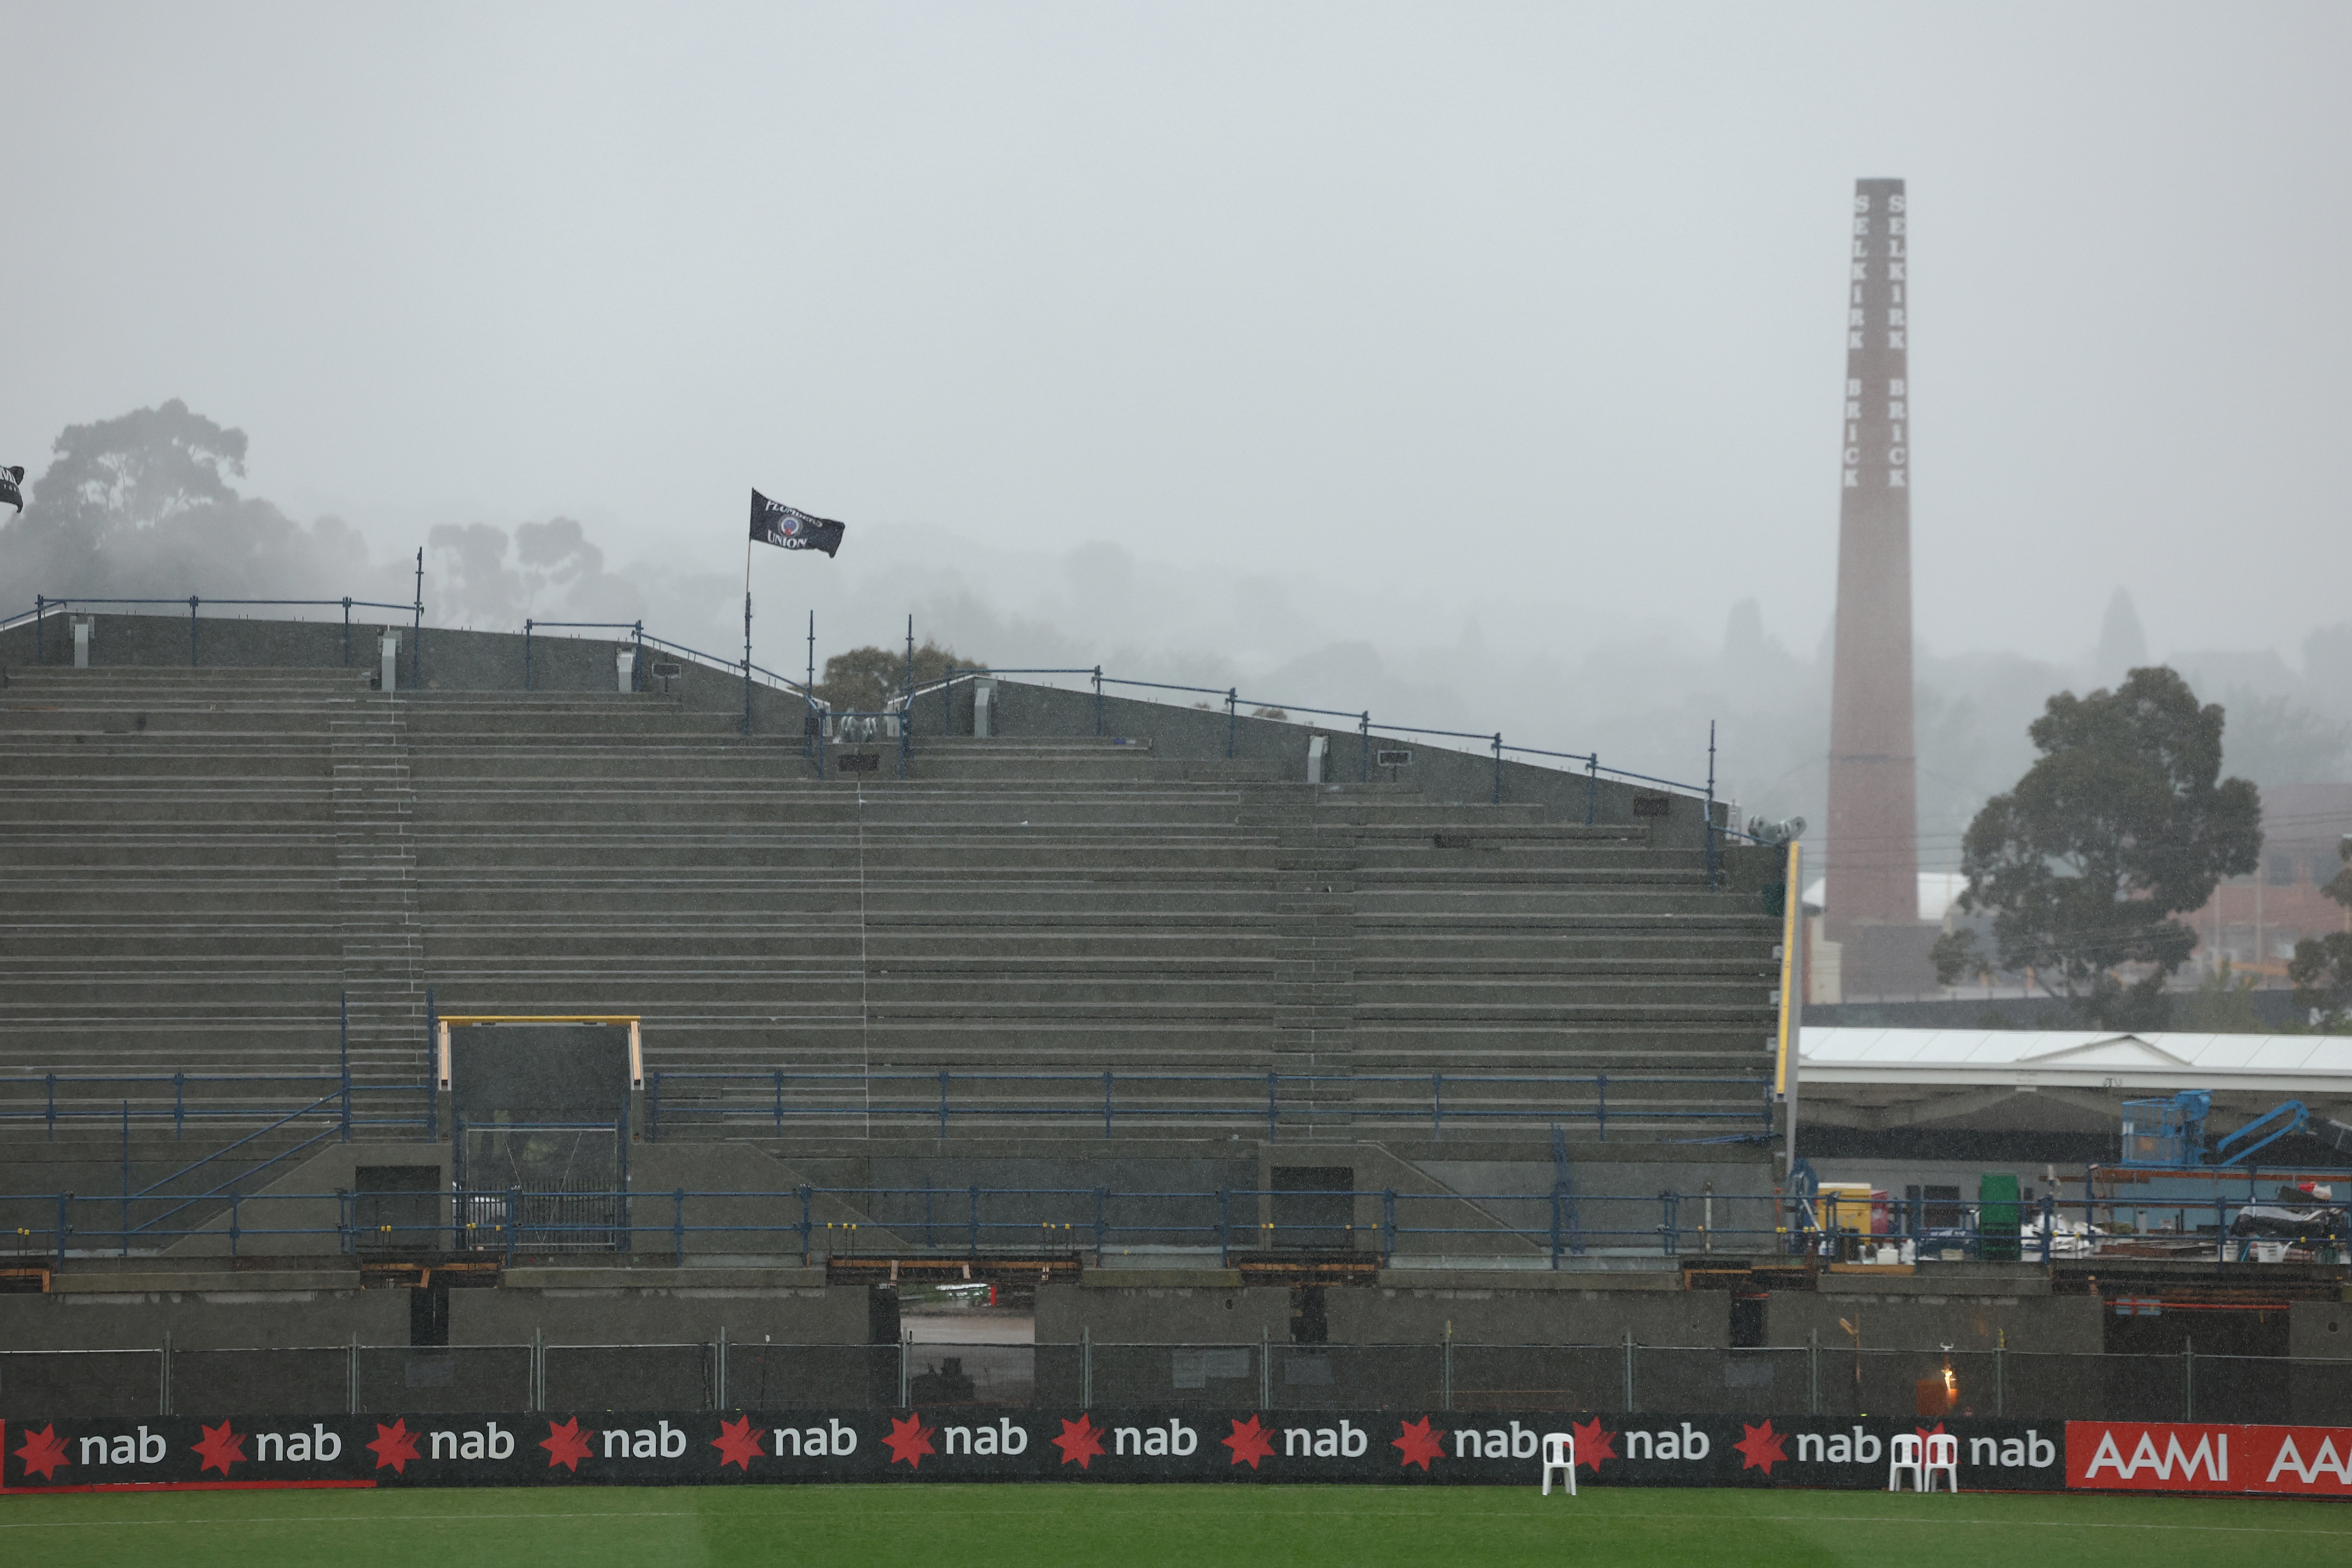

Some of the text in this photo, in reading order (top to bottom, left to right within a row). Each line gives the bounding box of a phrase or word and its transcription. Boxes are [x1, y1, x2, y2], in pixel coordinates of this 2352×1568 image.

[1844, 194, 1870, 487] SELKIRK BRICK
[1888, 194, 1906, 487] SELKIRK BRICK
[767, 529, 808, 549] UNION
[80, 1425, 166, 1465] nab
[256, 1423, 341, 1461] nab
[430, 1422, 515, 1460] nab
[603, 1420, 686, 1458] nab
[773, 1418, 857, 1456] nab
[944, 1417, 1028, 1455] nab
[1114, 1418, 1198, 1456] nab
[1284, 1420, 1368, 1457] nab
[1454, 1421, 1538, 1458] nab
[1625, 1422, 1709, 1460] nab
[1797, 1426, 1881, 1463] nab
[1969, 1430, 2055, 1468] nab
[2085, 1430, 2228, 1482] AAMI
[2266, 1434, 2352, 1485] AA
